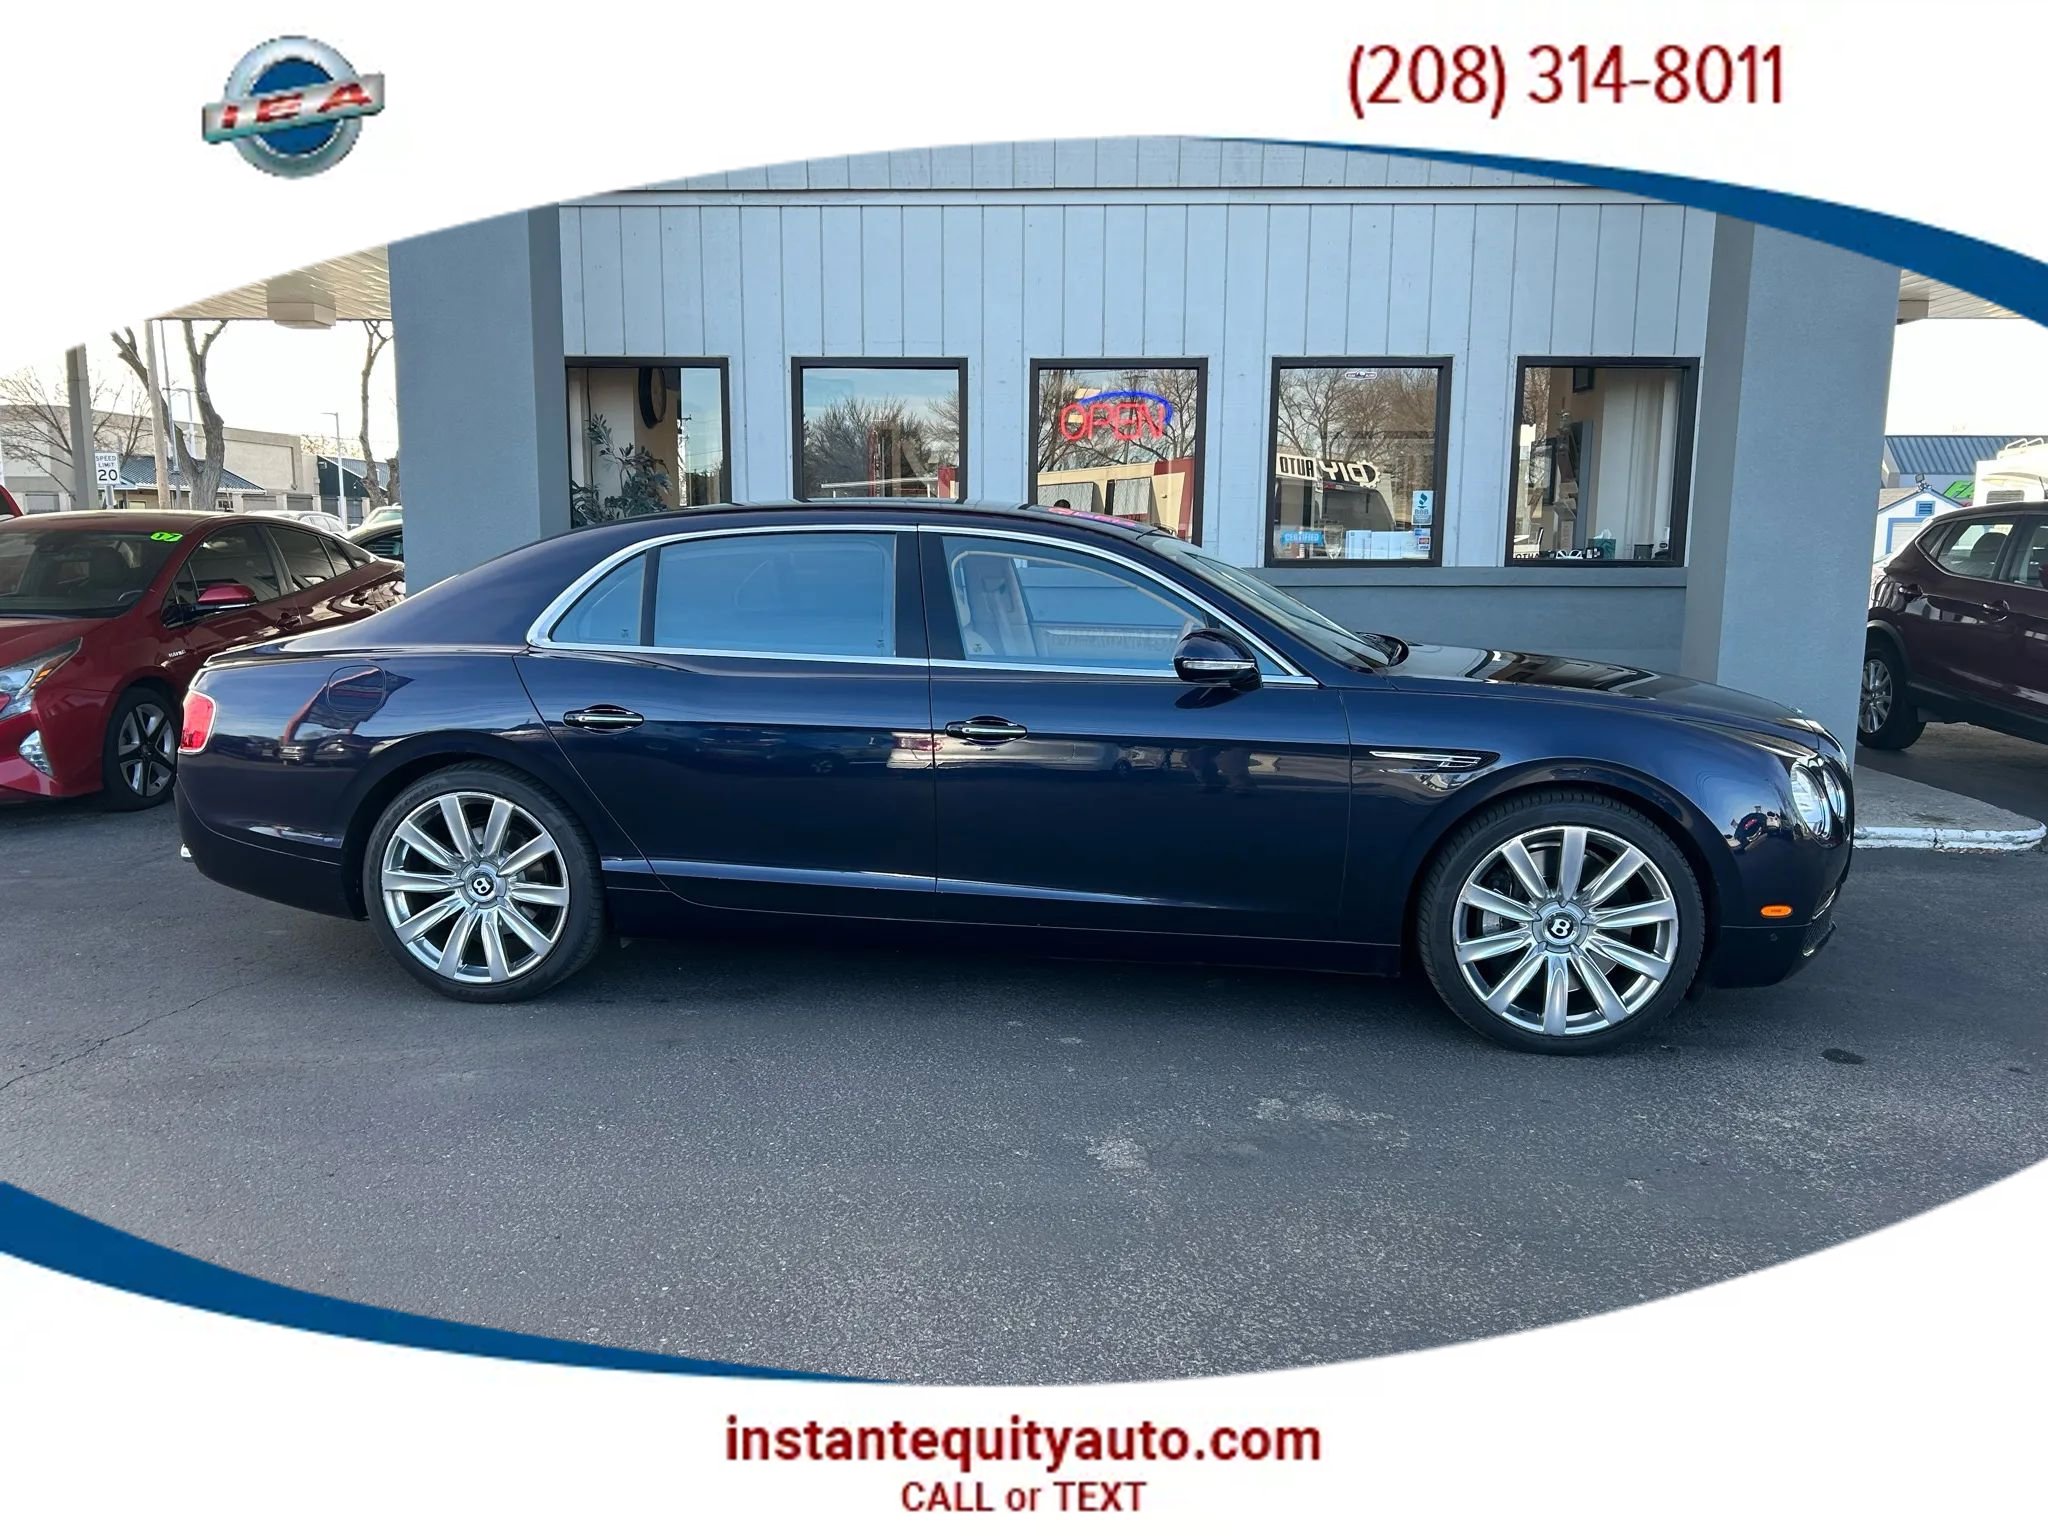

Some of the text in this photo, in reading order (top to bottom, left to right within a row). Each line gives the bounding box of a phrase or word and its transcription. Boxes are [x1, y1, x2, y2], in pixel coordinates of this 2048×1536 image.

[1061, 402, 1165, 441] OPEN
[98, 469, 118, 481] 20
[1284, 533, 1319, 541] CERTIFIED
